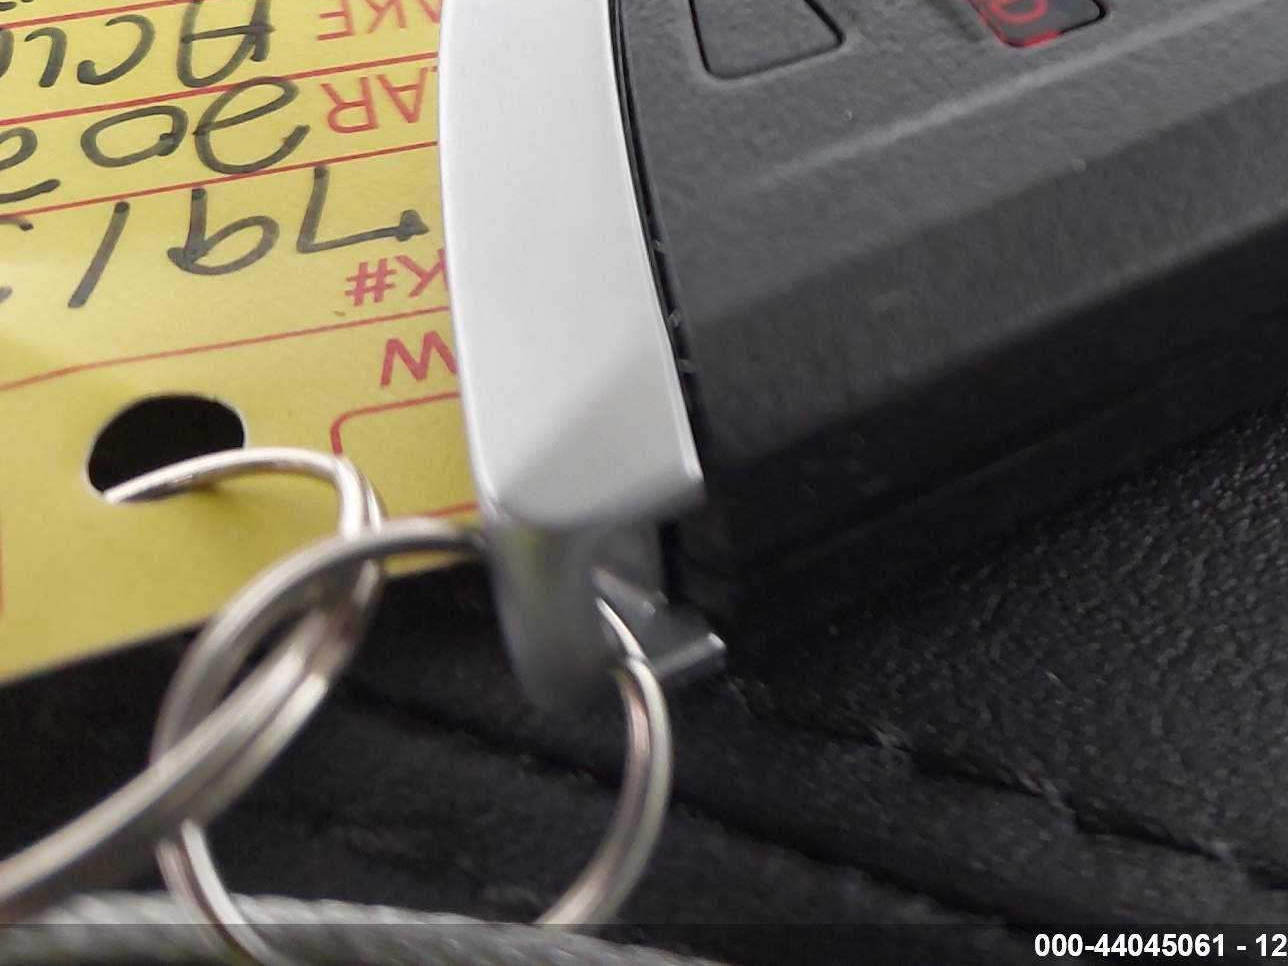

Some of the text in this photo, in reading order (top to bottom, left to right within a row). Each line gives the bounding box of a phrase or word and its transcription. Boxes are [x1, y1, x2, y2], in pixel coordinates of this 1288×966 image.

[320, 66, 438, 135] AR
[344, 247, 449, 307] K#
[379, 330, 458, 389] W
